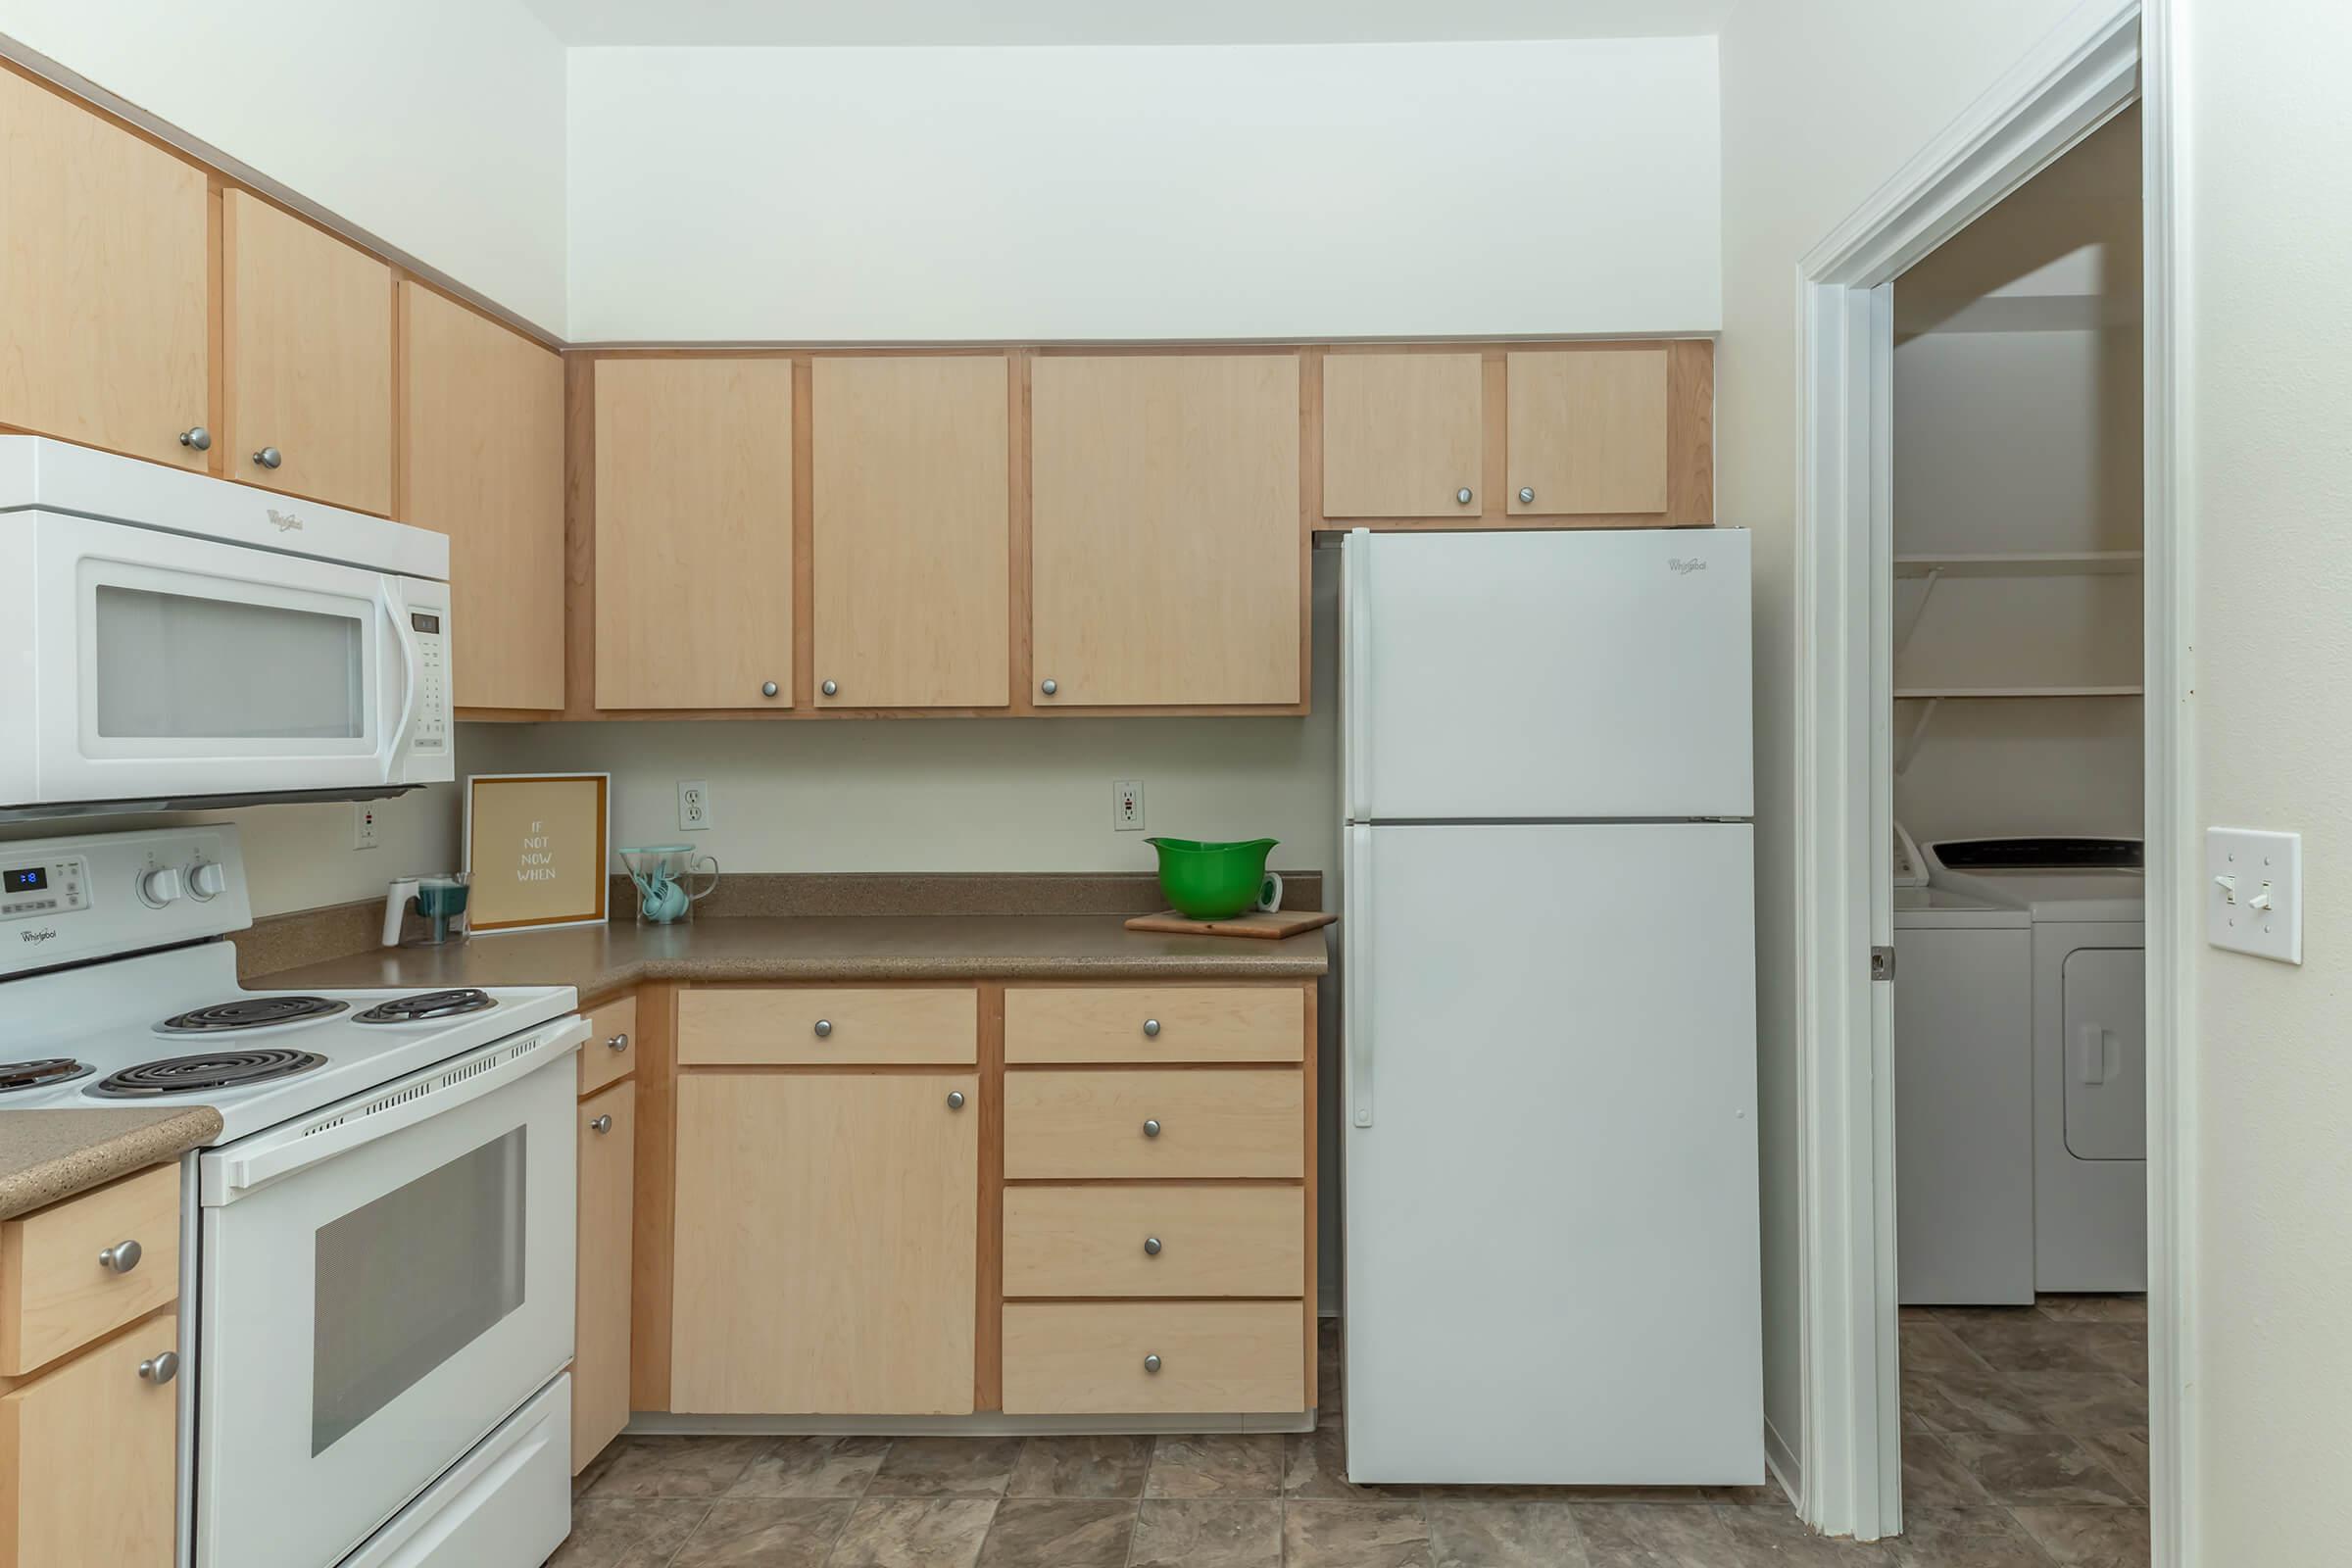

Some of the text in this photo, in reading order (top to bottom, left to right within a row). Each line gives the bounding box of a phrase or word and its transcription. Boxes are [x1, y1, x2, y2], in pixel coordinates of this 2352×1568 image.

[532, 821, 542, 833] IF
[524, 837, 549, 849] NOT
[521, 853, 552, 865] NOW
[517, 868, 556, 881] WHEN
[20, 928, 56, 945] Whirlpool
